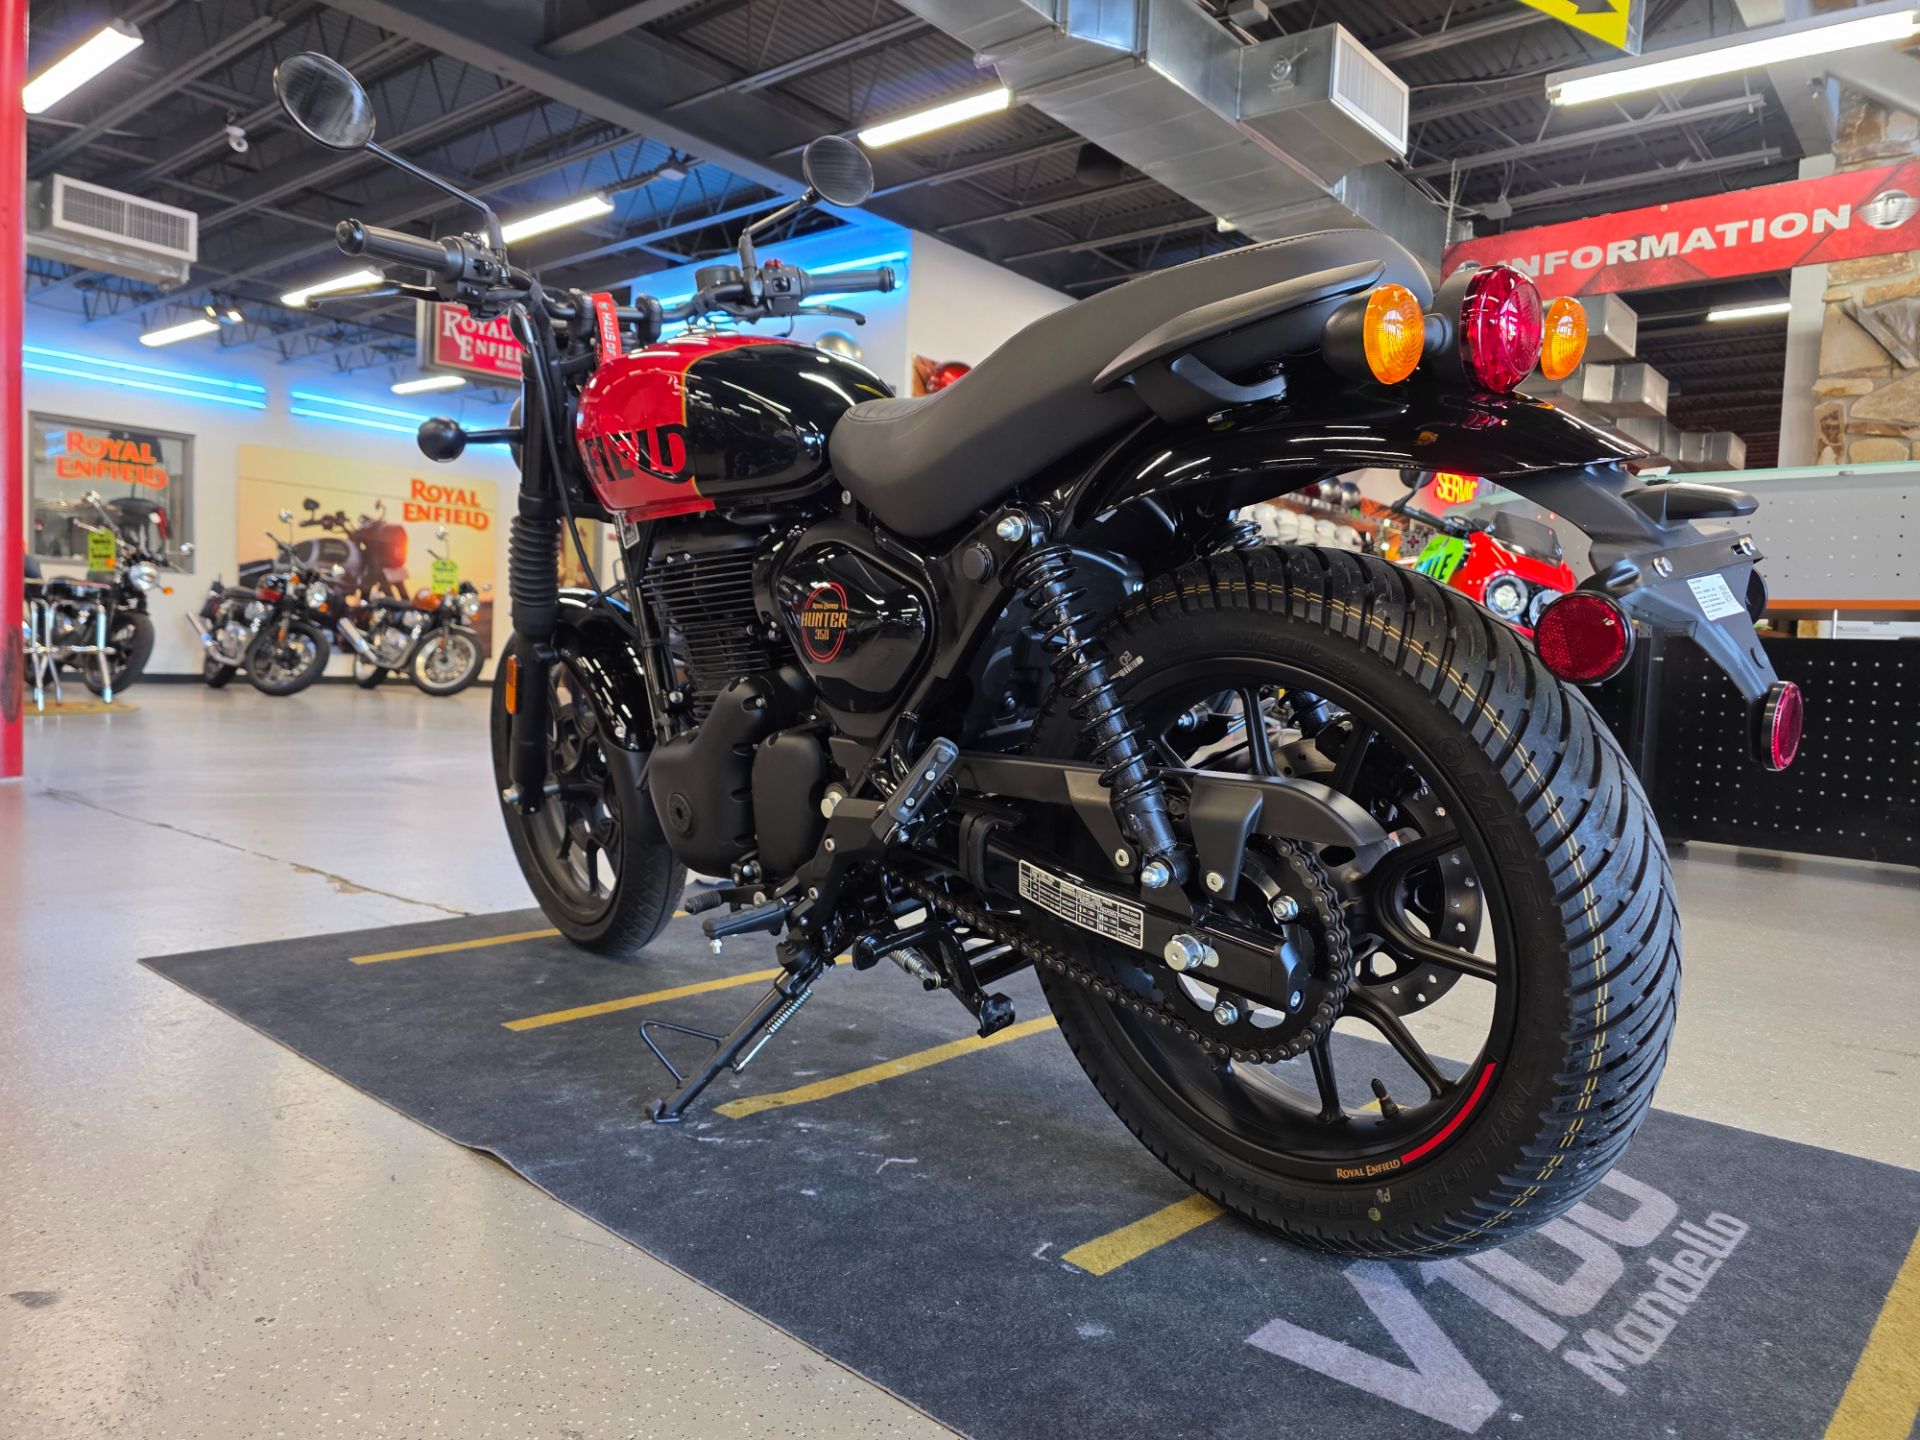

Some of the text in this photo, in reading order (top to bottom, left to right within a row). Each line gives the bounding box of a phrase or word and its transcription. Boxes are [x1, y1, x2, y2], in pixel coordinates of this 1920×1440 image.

[1497, 203, 1851, 278] NFORMATION
[443, 310, 512, 341] ROYAL
[66, 430, 157, 465] ROYAL
[55, 456, 169, 491] ENFIELD
[411, 479, 481, 508] ROYAL
[403, 501, 489, 531] ENFIELD
[801, 612, 848, 628] HUNTER
[815, 628, 830, 640] 350
[1336, 1159, 1400, 1178] ROYAL ENFIELD
[1563, 1210, 1750, 1397] Mandello
